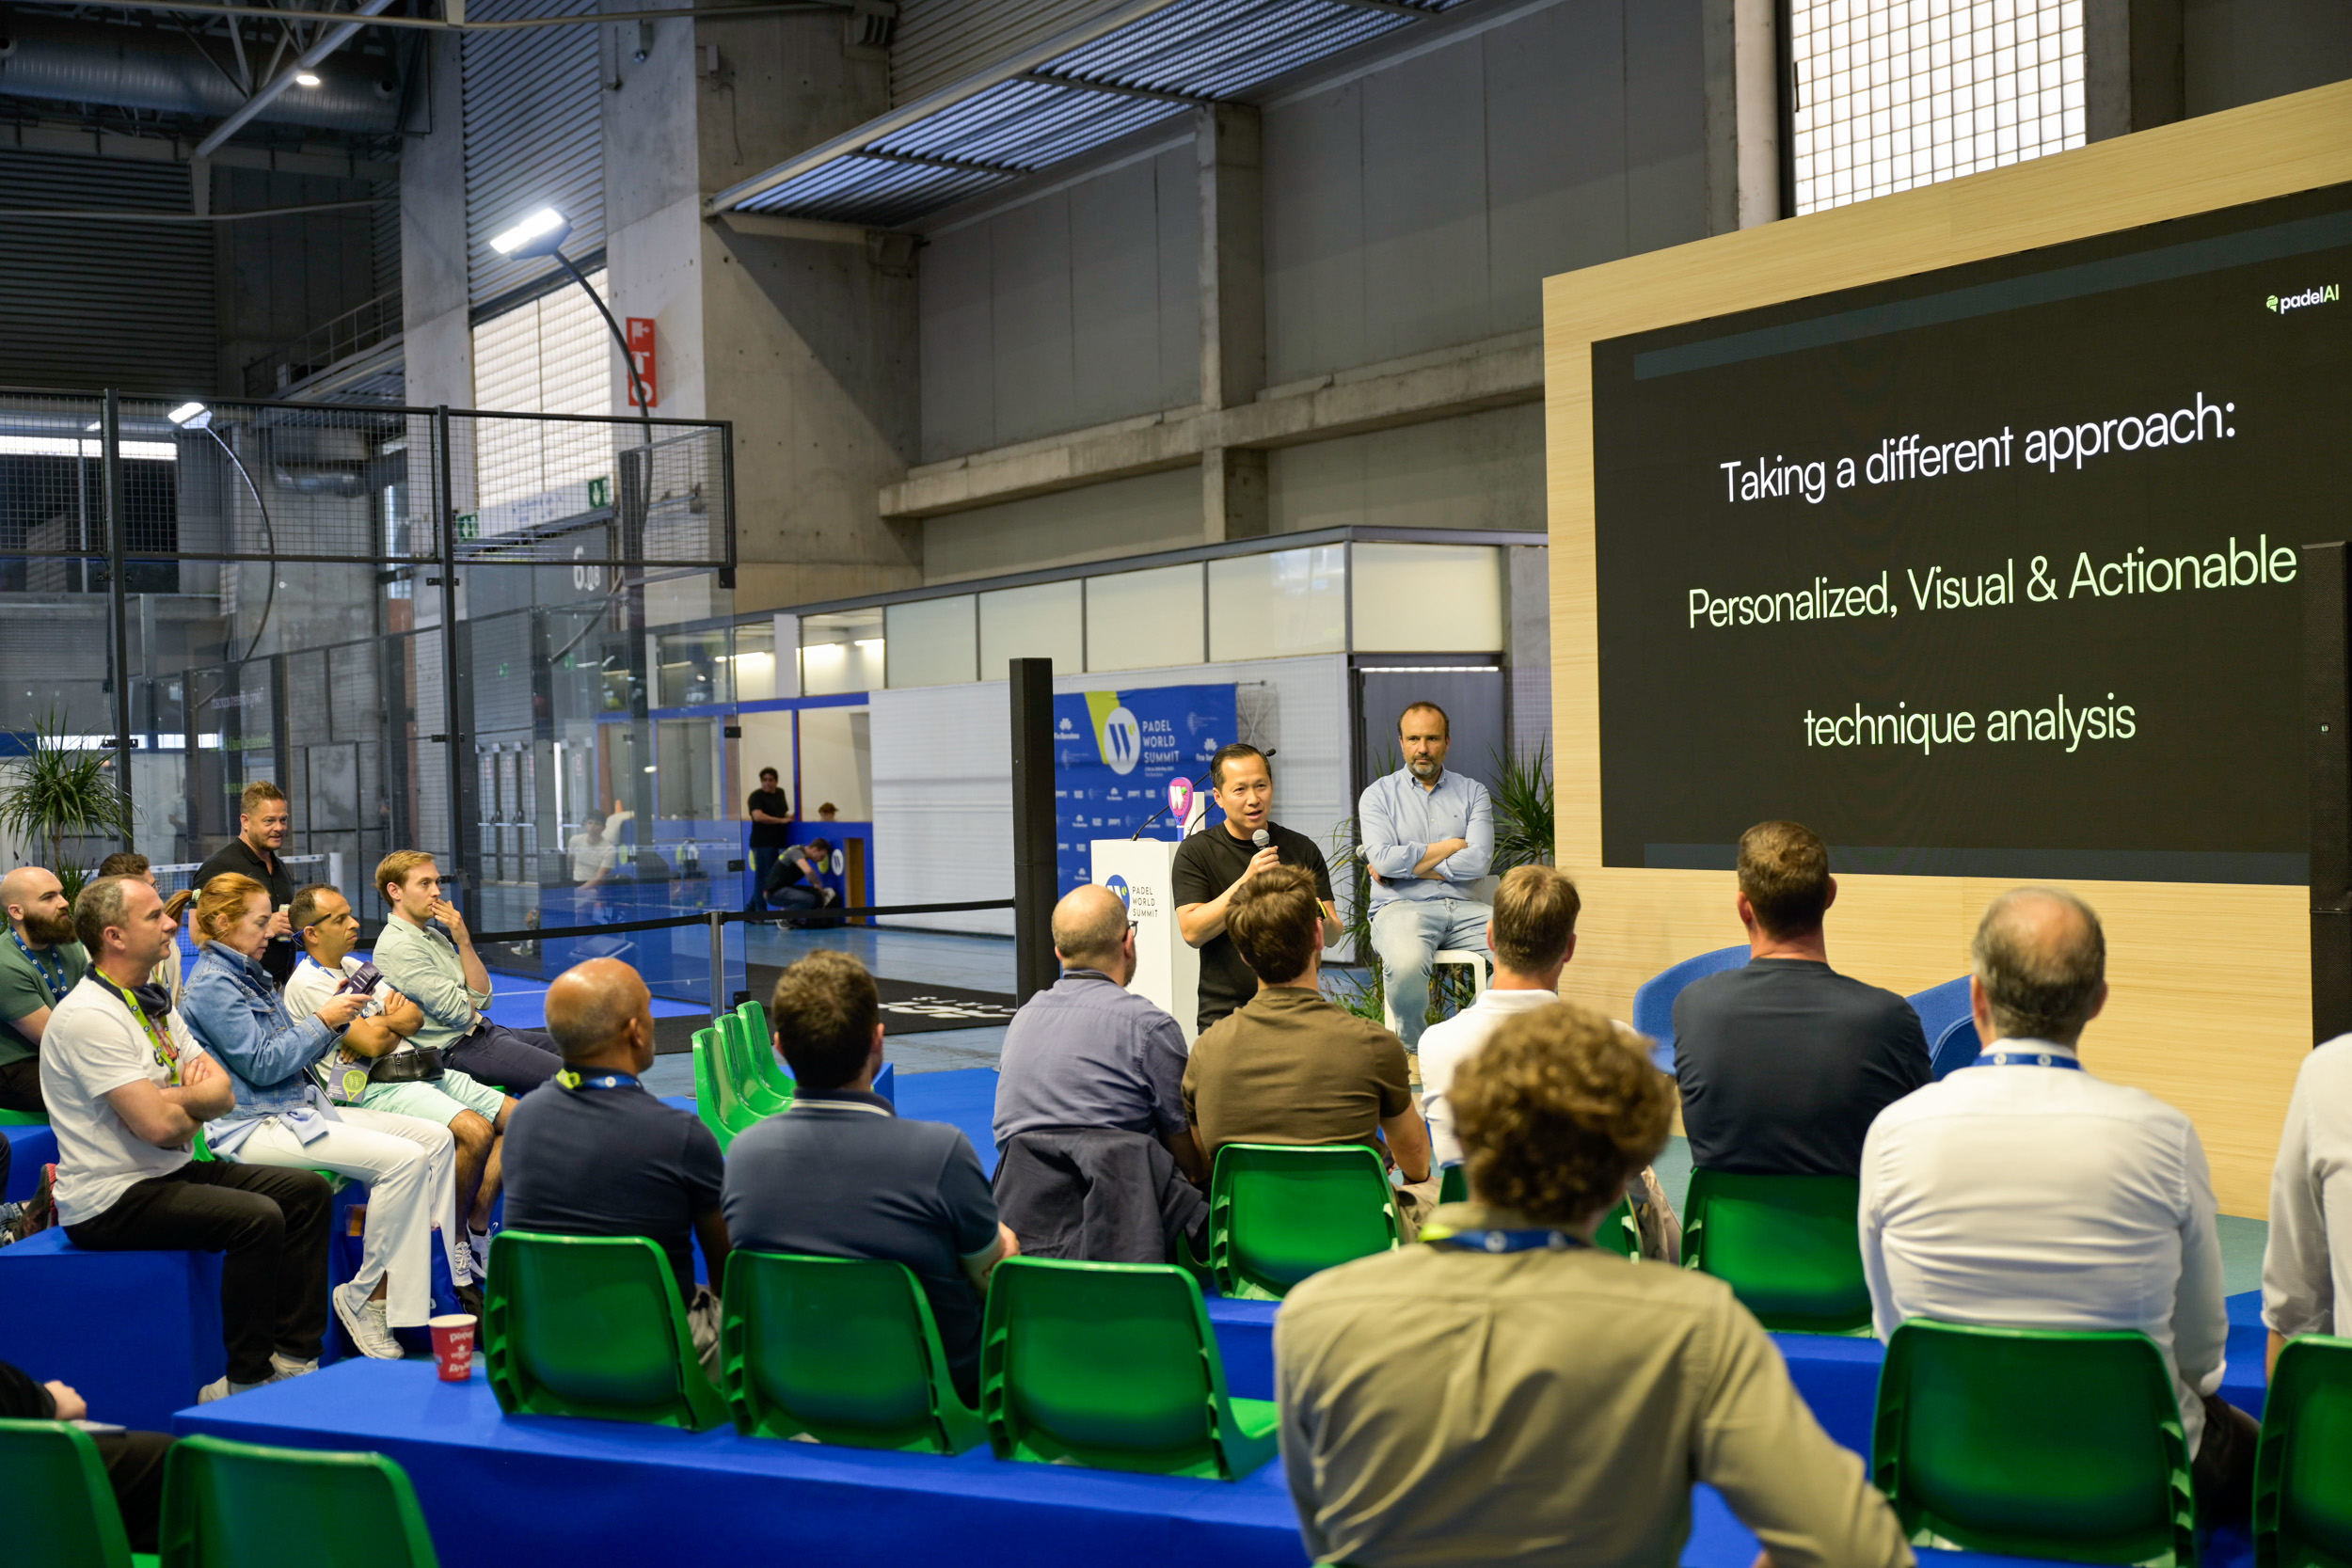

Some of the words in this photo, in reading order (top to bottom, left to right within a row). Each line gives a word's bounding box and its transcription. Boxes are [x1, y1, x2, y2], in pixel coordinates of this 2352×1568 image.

[2280, 283, 2340, 315] padelAI
[1720, 454, 1826, 504] Taking
[1836, 457, 1856, 489] a
[1866, 425, 2014, 484] different
[2025, 391, 2236, 473] approach:
[1689, 570, 1898, 629] Personalized,
[1906, 558, 2014, 611] Visual
[2026, 555, 2059, 603] &
[2068, 533, 2297, 599] Actionable
[1142, 720, 1172, 733] PADEL
[1803, 701, 1976, 756] technique
[1986, 691, 2137, 753] analysis
[1143, 735, 1176, 748] WORLD
[1144, 750, 1180, 764] SUMMIT
[1132, 886, 1153, 895] PADEL
[1132, 897, 1156, 907] WORLD
[1132, 908, 1158, 918] SUMMIT
